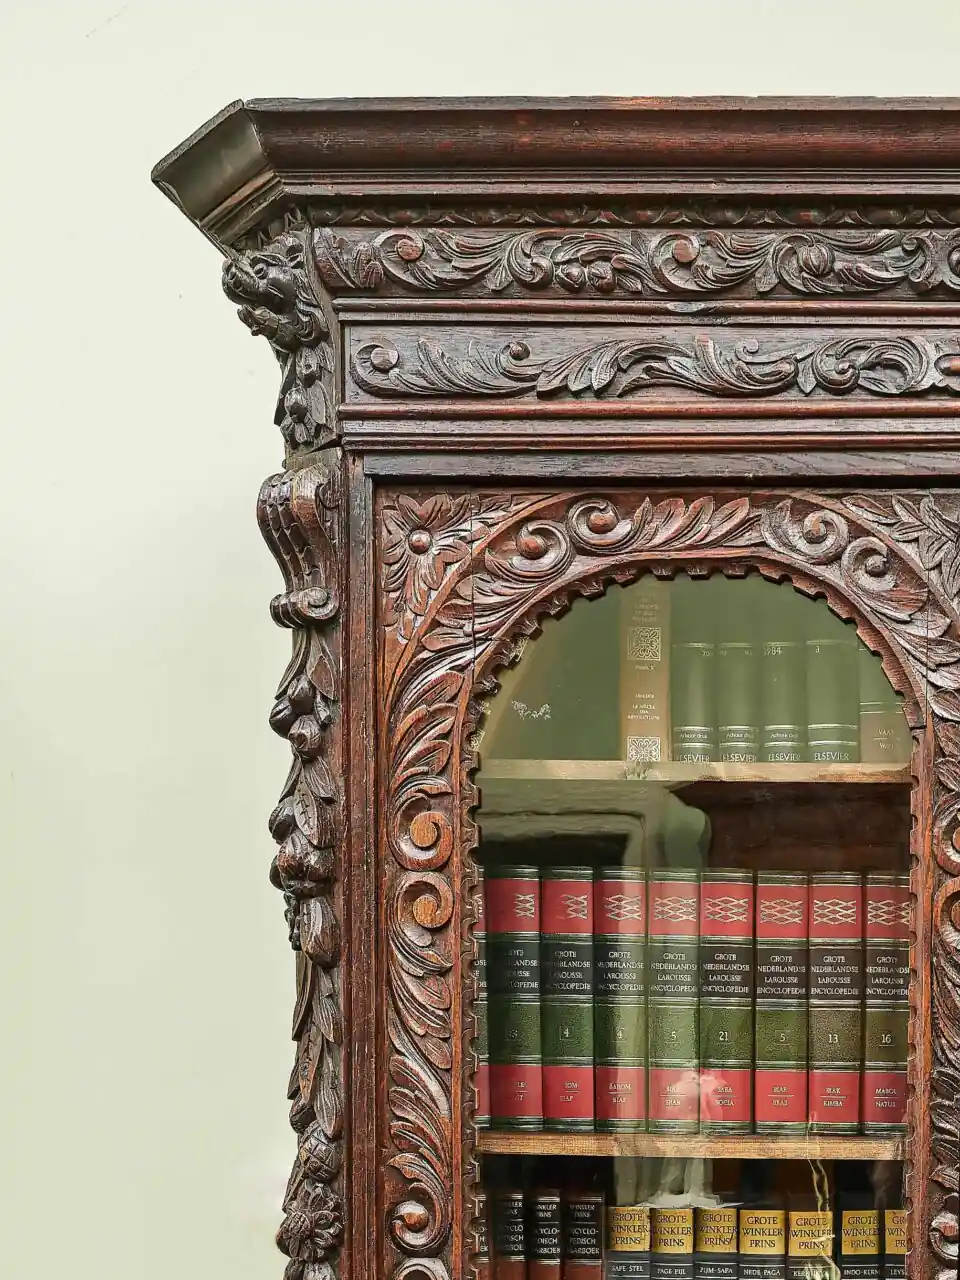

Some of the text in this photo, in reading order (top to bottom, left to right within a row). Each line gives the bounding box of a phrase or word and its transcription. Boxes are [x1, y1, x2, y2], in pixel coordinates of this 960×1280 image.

[814, 752, 849, 761] ELSEVIER
[719, 1031, 728, 1041] 21
[828, 1034, 838, 1043] 13
[882, 1034, 891, 1043] 16
[703, 1214, 732, 1222] GROTE
[747, 1216, 778, 1225] GROTE
[796, 1217, 827, 1226] GROTE
[848, 1216, 878, 1225] GROTE
[742, 1228, 784, 1236] WINKLER
[791, 1229, 832, 1238] WINKLER
[660, 1239, 684, 1247] PRINS
[704, 1237, 730, 1245] PRINS
[750, 1240, 776, 1248] PRINS
[798, 1241, 825, 1249] PRINS
[851, 1240, 876, 1248] PRINS
